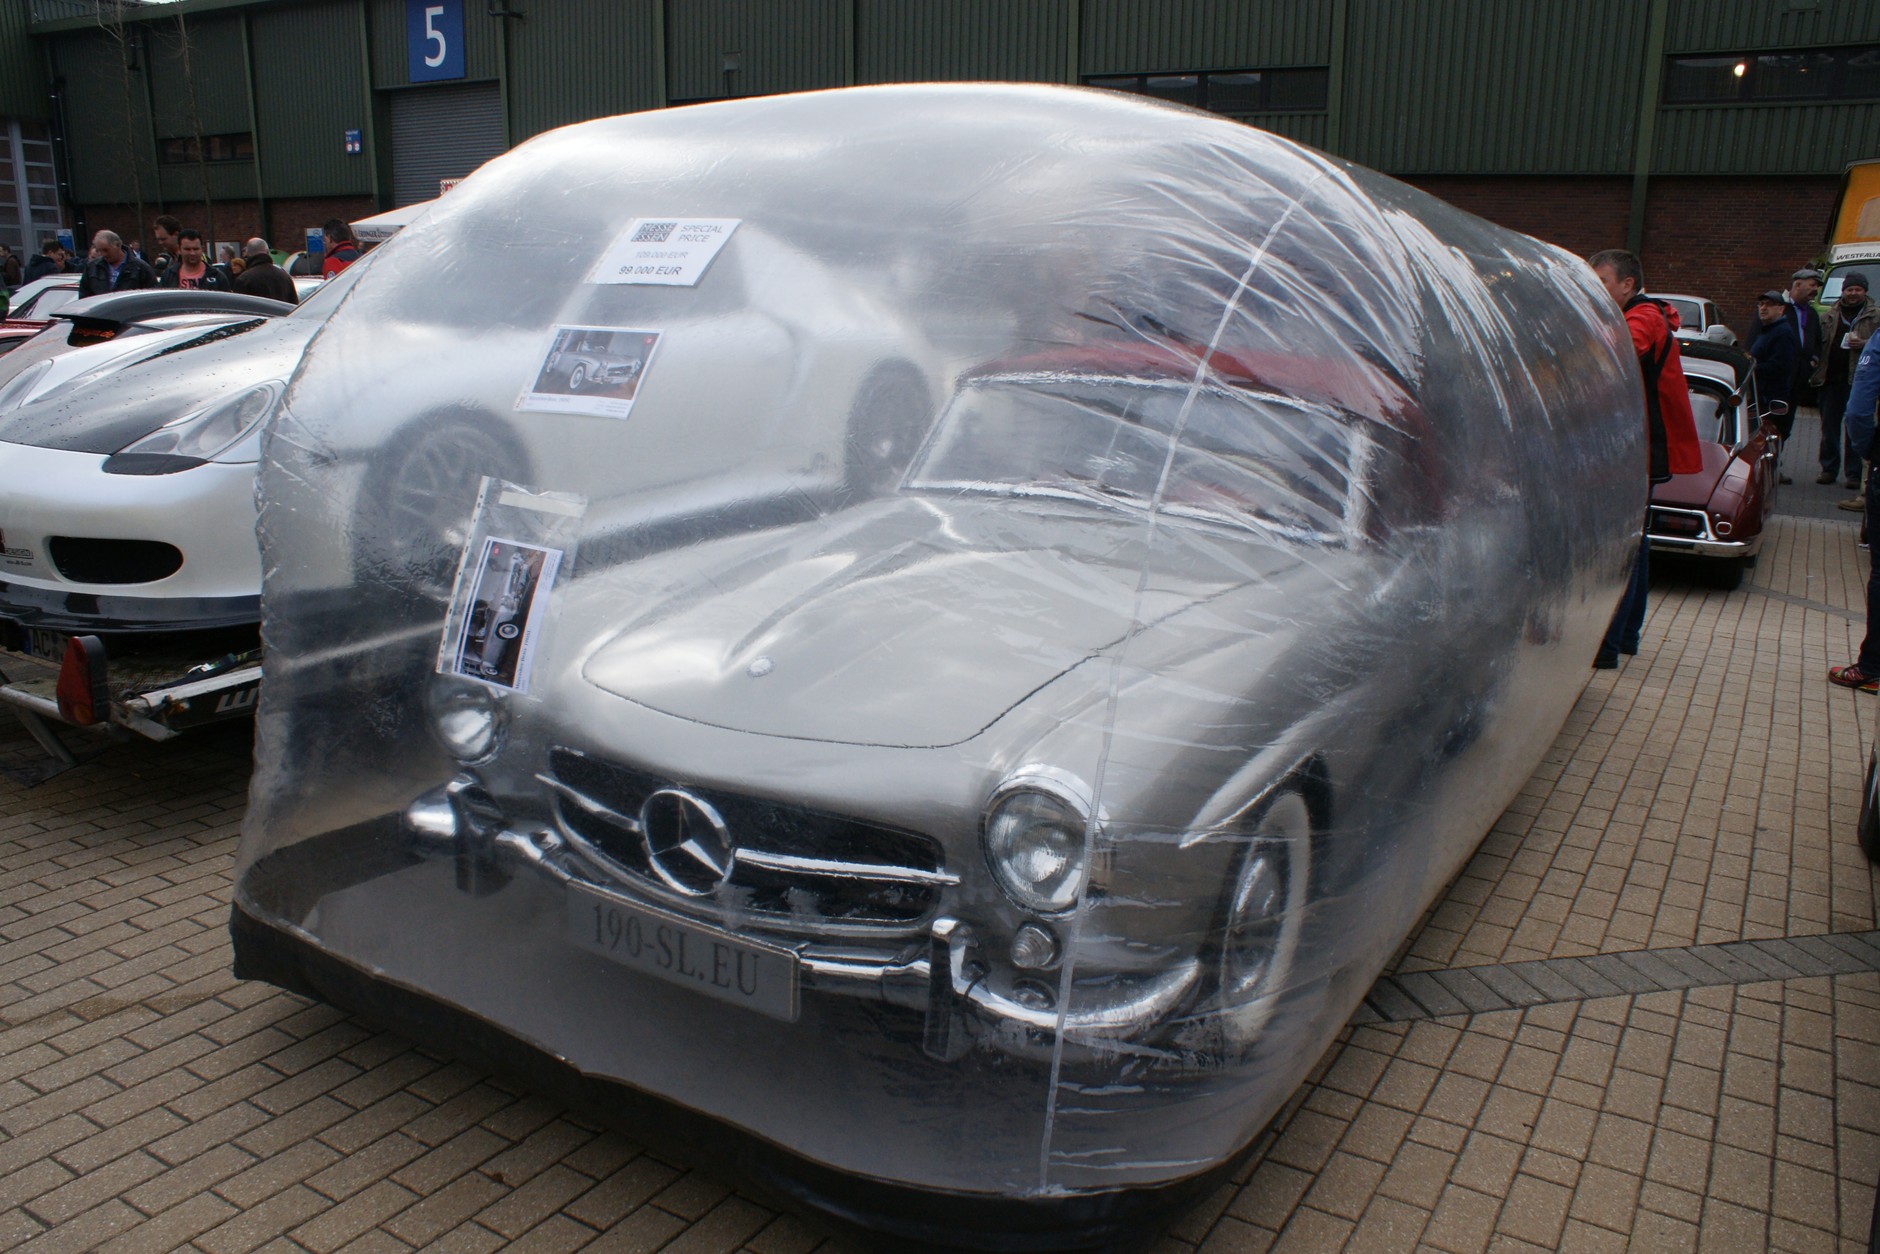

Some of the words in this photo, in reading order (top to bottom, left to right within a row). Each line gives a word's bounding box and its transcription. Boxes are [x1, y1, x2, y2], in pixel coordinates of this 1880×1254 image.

[425, 5, 447, 68] 5
[640, 223, 677, 232] MESSE
[681, 225, 723, 233] SPECIAL
[633, 232, 669, 242] ESSEN
[678, 234, 711, 242] PRICE
[668, 251, 689, 259] EUR
[1836, 252, 1880, 261] WESTFALIA
[618, 266, 655, 275] 99.000
[656, 266, 682, 275] EUR
[592, 903, 760, 997] 190-SL.EU
